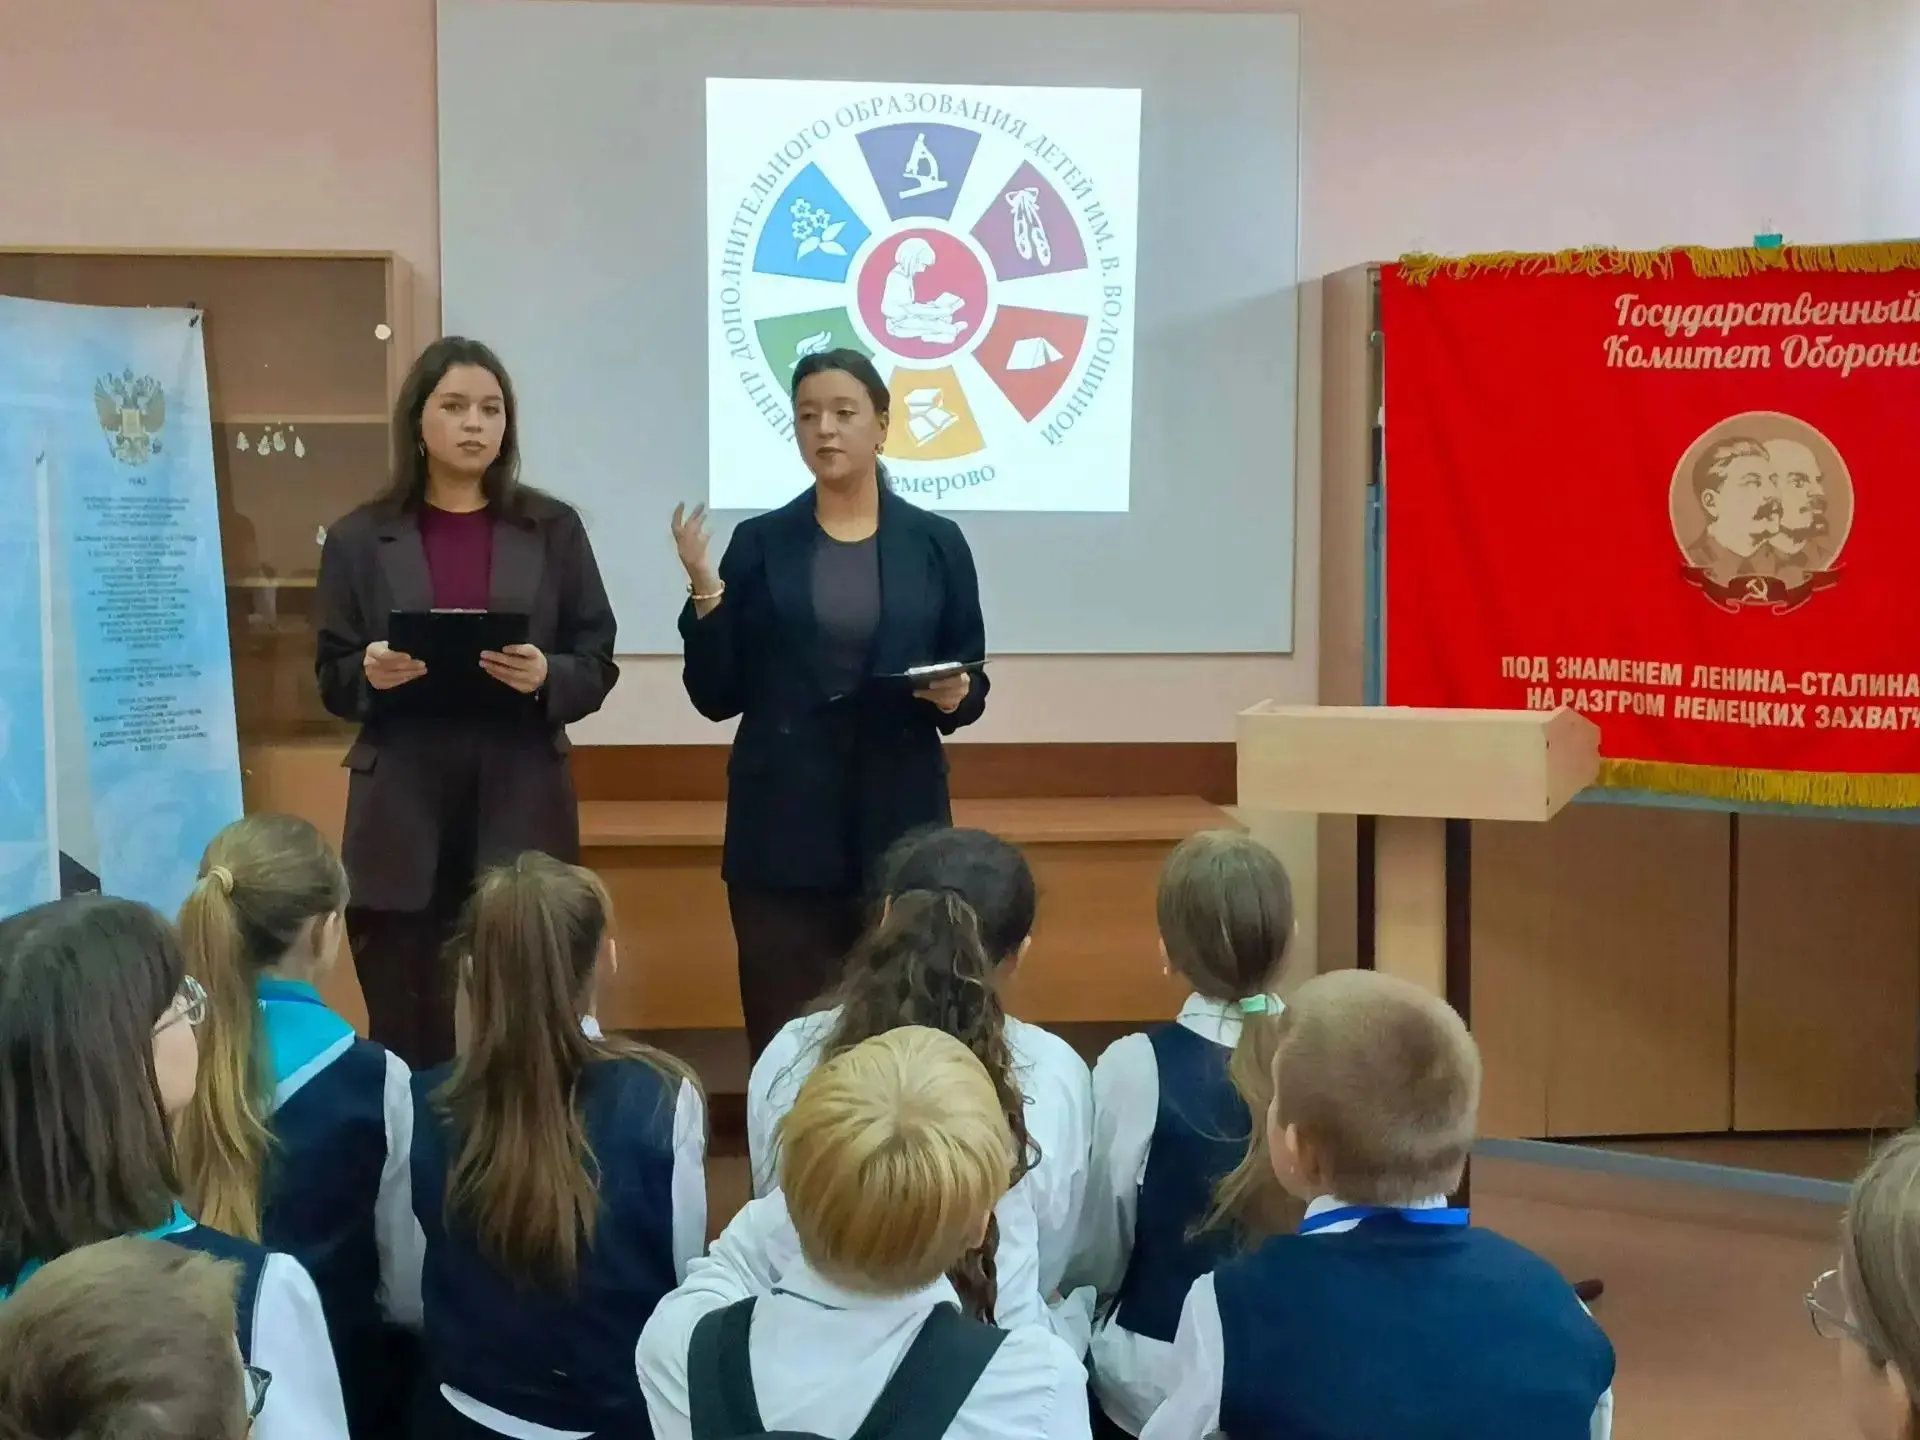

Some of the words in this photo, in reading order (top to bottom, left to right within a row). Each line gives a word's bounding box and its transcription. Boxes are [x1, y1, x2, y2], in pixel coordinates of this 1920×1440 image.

[835, 92, 1028, 140] ОБРАЗОВАНИЯ
[1023, 134, 1095, 200] ДЕТЕЙ
[719, 119, 831, 361] ДОПОЛНИТЕЛЬНОГО
[1083, 201, 1115, 251] ИМ.
[1100, 256, 1120, 277] В.
[1614, 289, 1920, 337] Государственный
[1040, 284, 1122, 446] ВОЛОШИНОЙ
[1602, 334, 1771, 369] Комитет
[889, 464, 996, 500] емерово
[1501, 656, 1549, 683] ПОД
[1556, 656, 1682, 686] ЗНАМЕНЕМ
[1526, 687, 1556, 709] НА
[1561, 687, 1665, 717] РАЗГРОМ
[1674, 695, 1806, 728] НЕМЕЦКИХ
